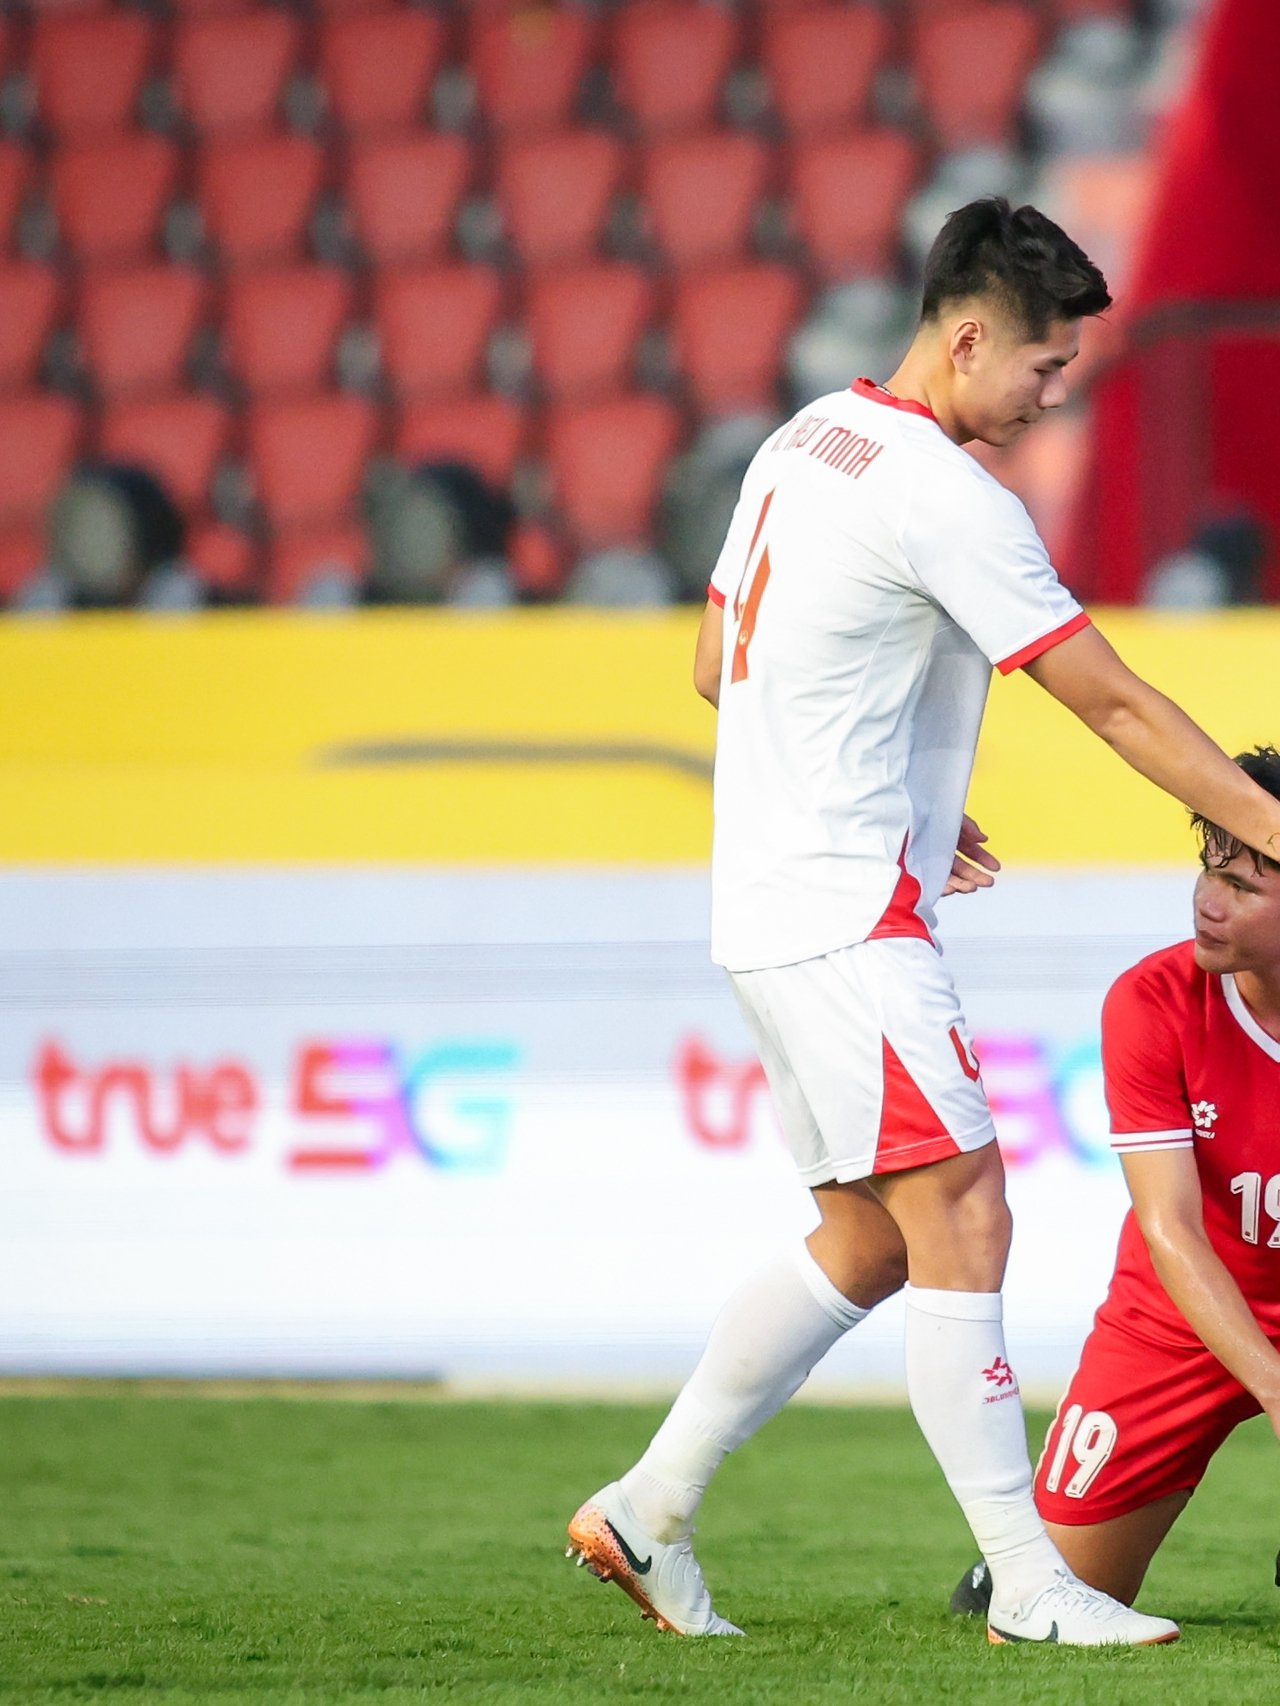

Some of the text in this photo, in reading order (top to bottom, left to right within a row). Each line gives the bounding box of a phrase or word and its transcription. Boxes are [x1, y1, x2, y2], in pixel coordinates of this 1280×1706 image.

[808, 426, 885, 480] MINH
[33, 1036, 521, 1175] true 5G
[1046, 1404, 1118, 1499] 19
